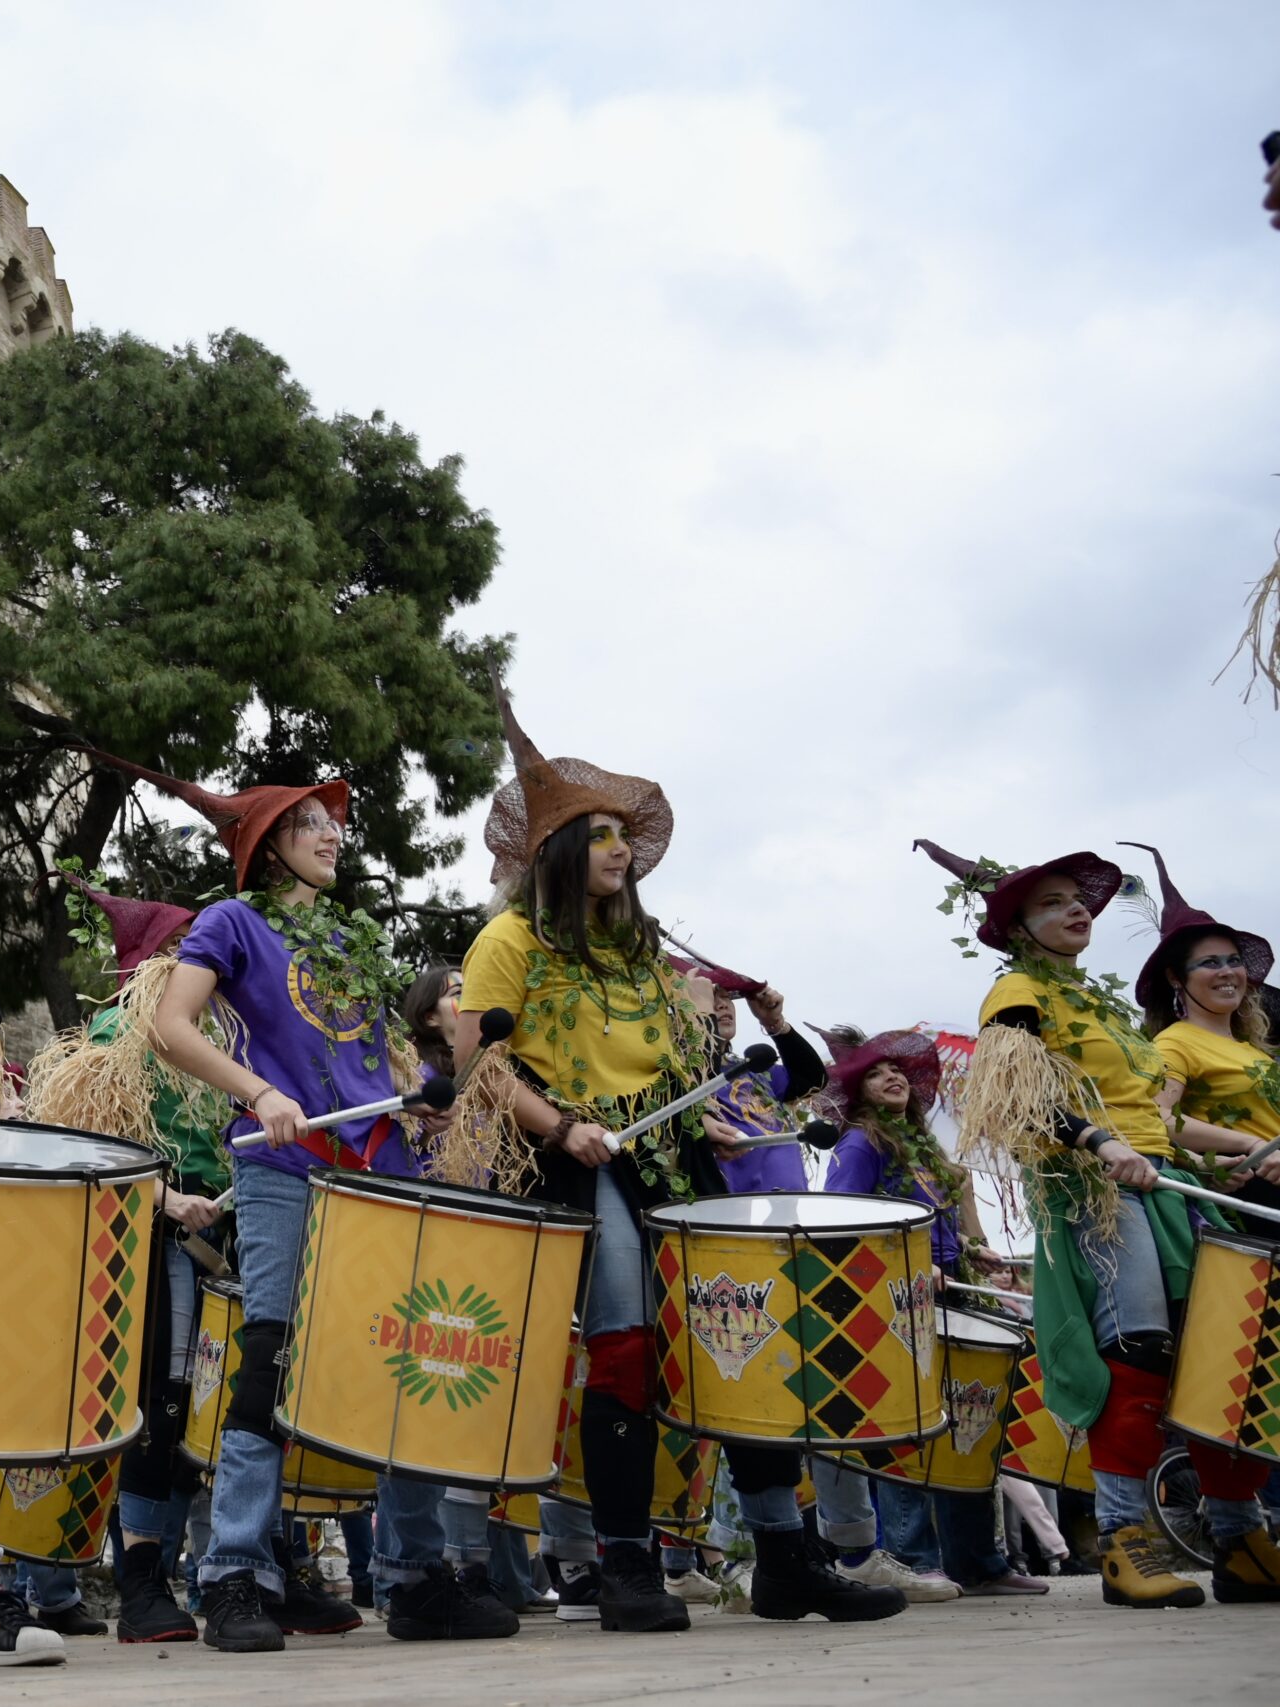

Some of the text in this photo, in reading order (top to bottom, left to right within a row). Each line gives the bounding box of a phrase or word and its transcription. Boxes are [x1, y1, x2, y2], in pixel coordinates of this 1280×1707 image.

[429, 1311, 475, 1329] BLOCO
[379, 1314, 512, 1368] PARANAUÊ
[421, 1359, 467, 1378] GRECIA
